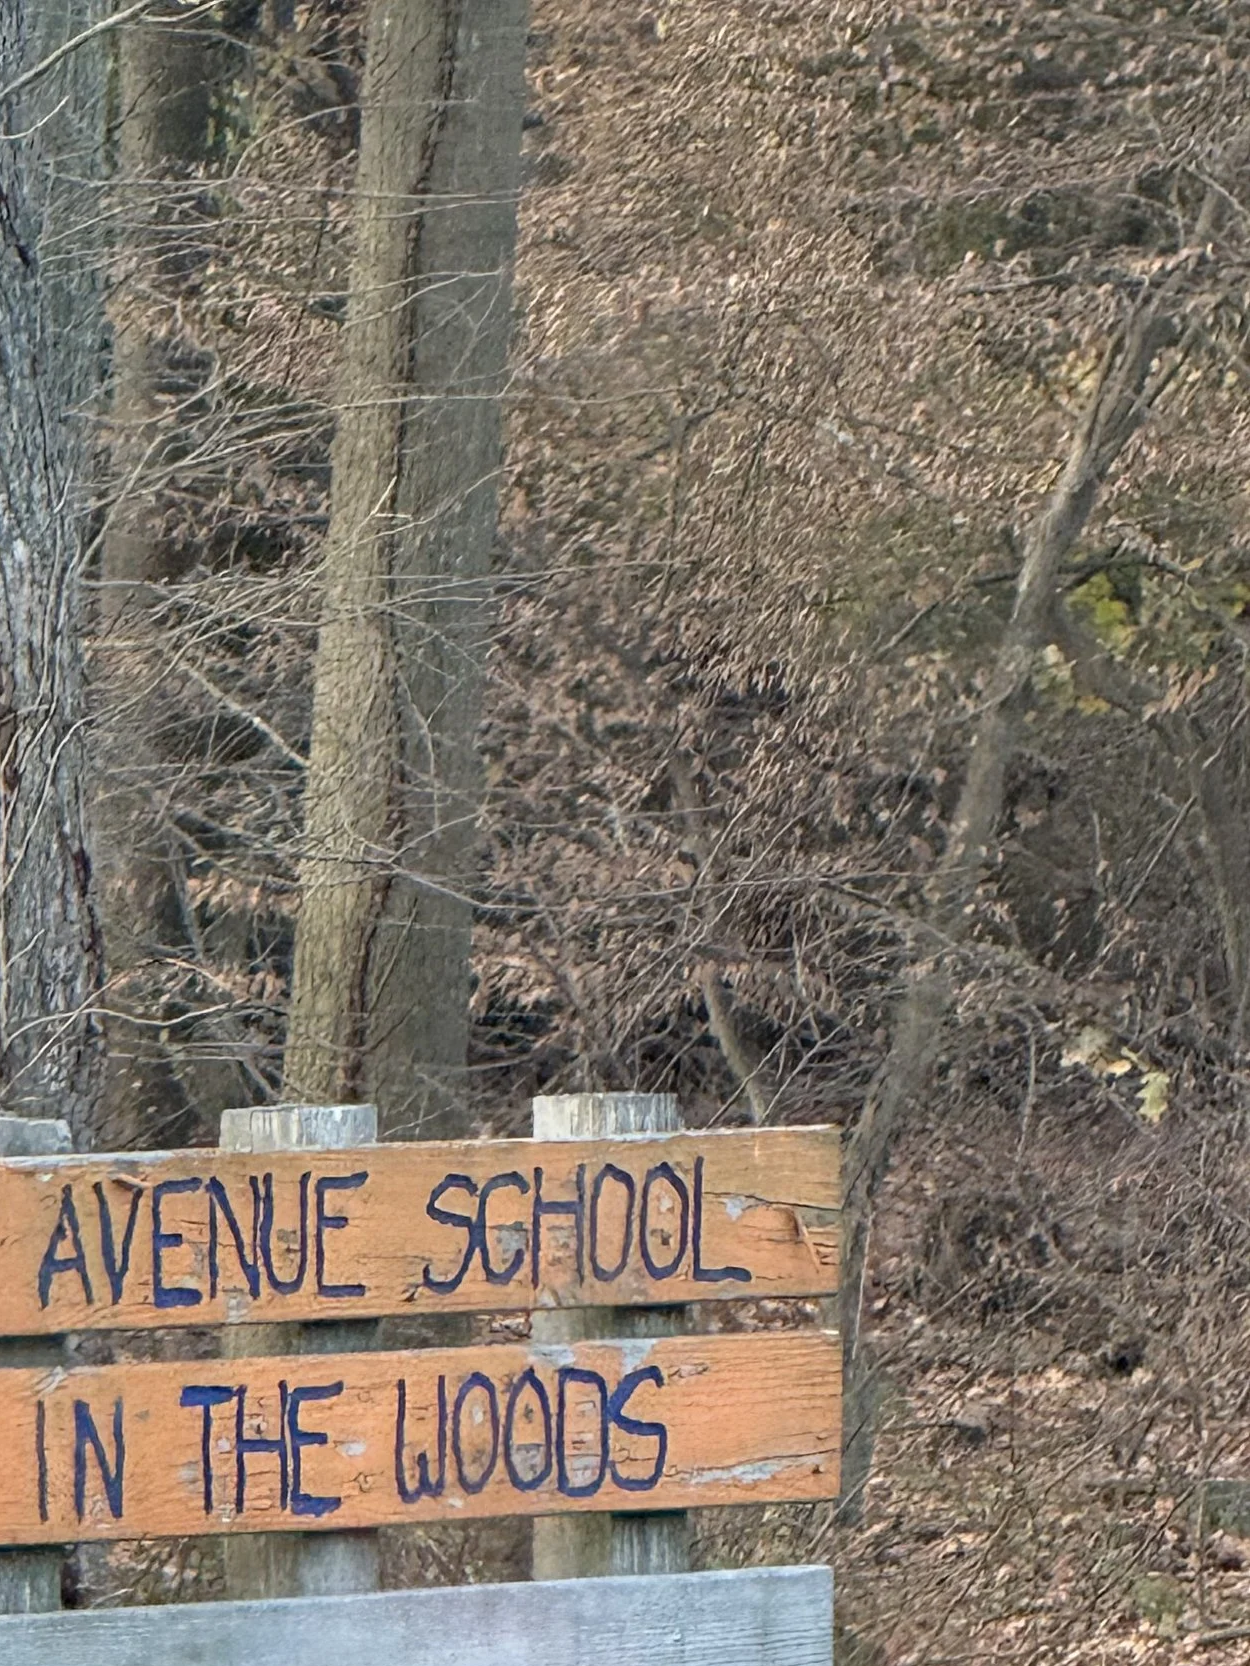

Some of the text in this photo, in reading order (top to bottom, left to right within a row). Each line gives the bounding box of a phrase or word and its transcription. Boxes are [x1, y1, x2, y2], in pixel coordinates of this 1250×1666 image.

[38, 1170, 368, 1309] AVENUE
[423, 1156, 752, 1295] SCHOOL
[37, 1396, 125, 1523] IN
[180, 1380, 344, 1517] THE
[395, 1366, 667, 1503] WOODS
